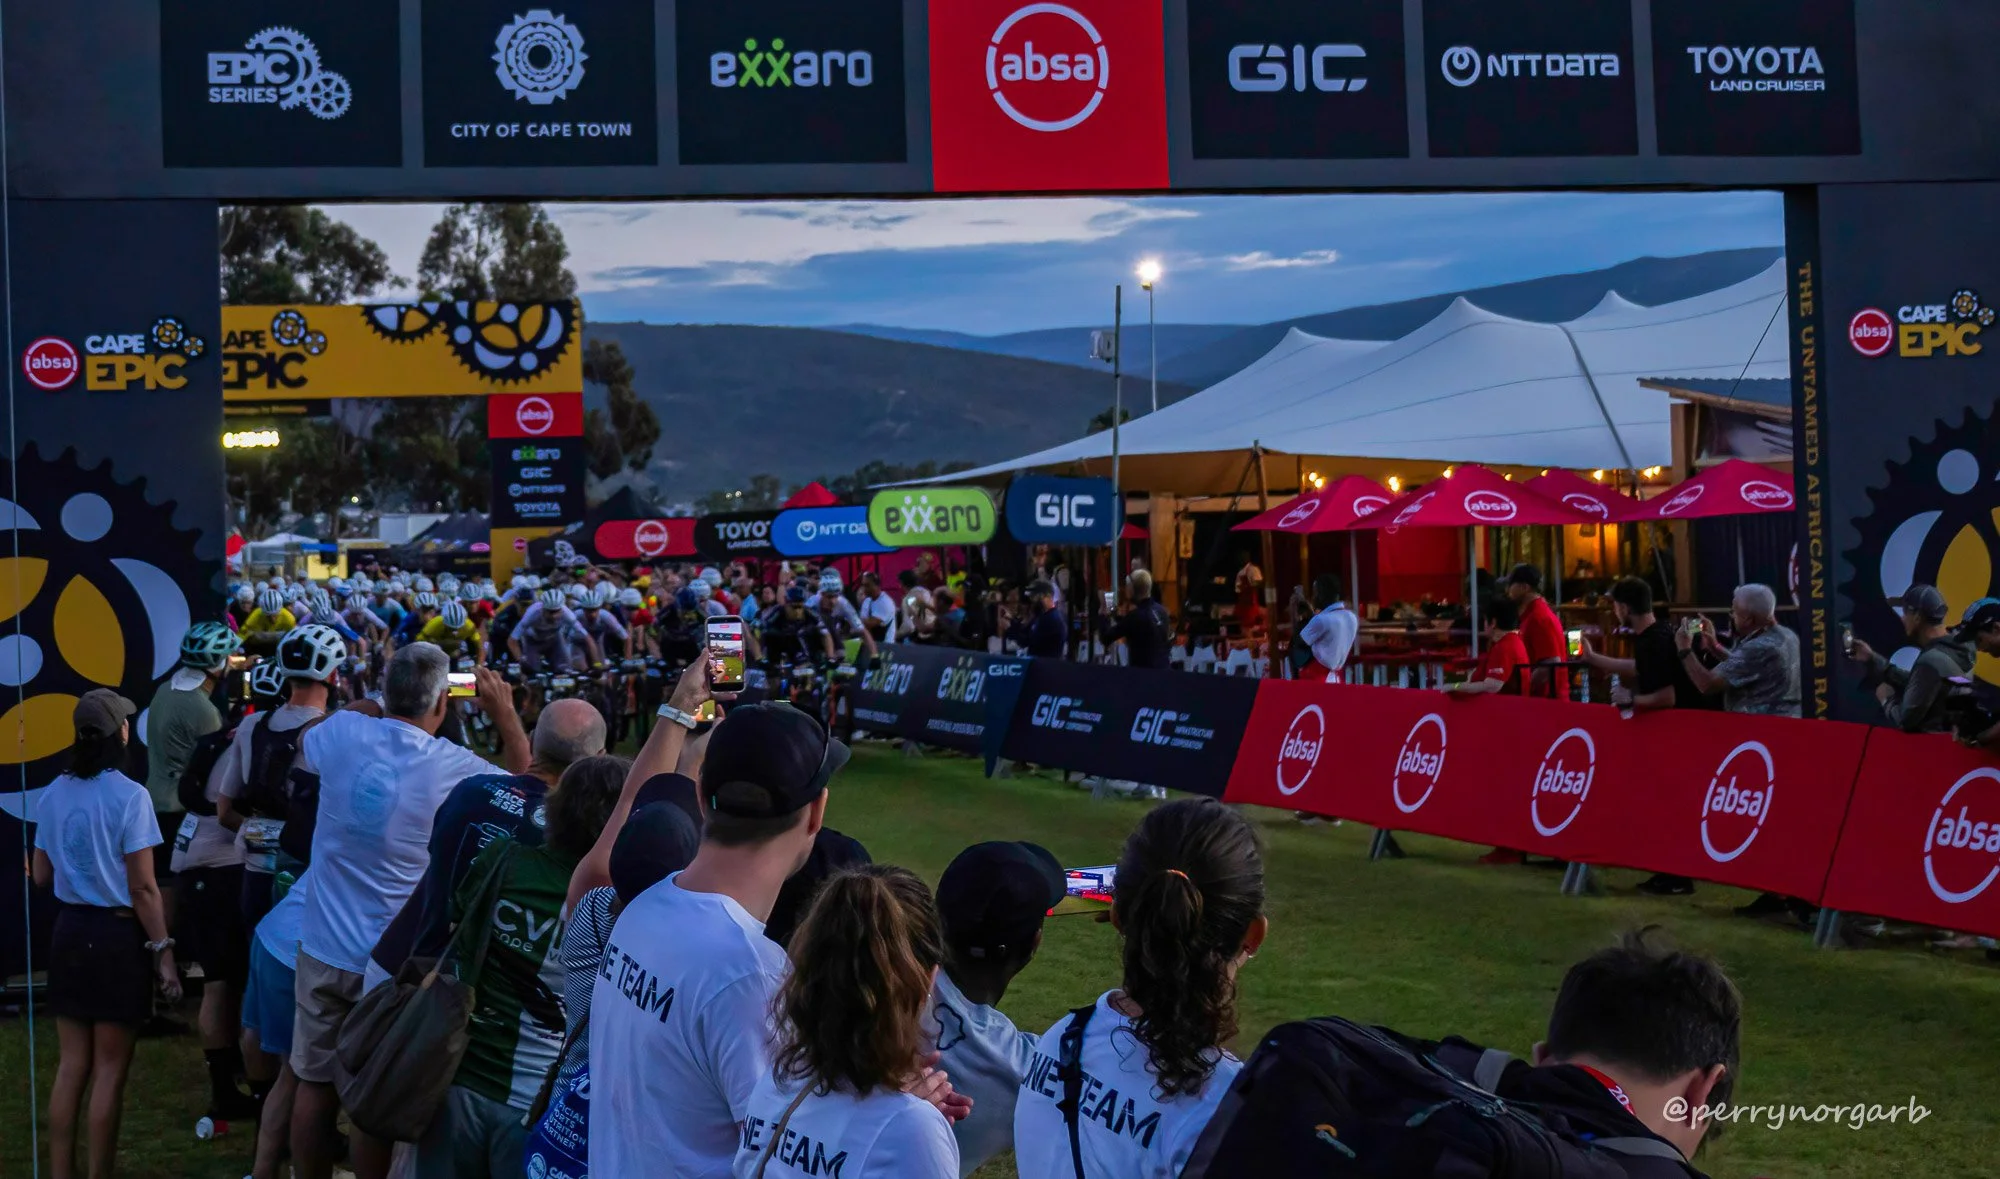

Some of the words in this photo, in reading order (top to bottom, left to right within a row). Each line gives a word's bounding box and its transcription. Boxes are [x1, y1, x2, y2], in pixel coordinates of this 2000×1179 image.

[207, 52, 292, 85] EPIC
[710, 38, 873, 89] exxaro
[1000, 40, 1095, 83] absa
[1227, 44, 1368, 93] GIC
[1486, 53, 1544, 78] NTT
[1687, 45, 1824, 75] TOYOTA
[208, 87, 279, 104] SERIES
[1709, 79, 1752, 92] LAND
[1754, 79, 1826, 92] CRUISER
[450, 122, 492, 138] CITY
[495, 122, 520, 138] OF
[525, 122, 572, 138] CAPE
[576, 121, 632, 138] TOWN
[1798, 262, 1814, 316] THE
[1898, 303, 1947, 324] CAPE
[85, 333, 145, 354] CAPE
[223, 330, 267, 349] APE
[1854, 324, 1890, 339] absa
[1898, 321, 1984, 358] EPIC
[31, 352, 72, 370] absa
[85, 354, 188, 391] EPIC
[1800, 325, 1820, 465] UNTAMED
[520, 408, 549, 421] absa
[513, 502, 562, 513] TOYOTA
[884, 495, 982, 534] exxaro
[1034, 493, 1096, 528] GIC
[1471, 500, 1511, 511] absa
[714, 521, 772, 540] TOYO
[819, 523, 846, 536] NTT
[1805, 473, 1826, 600] AFRICAN
[1812, 609, 1827, 669] MTB
[988, 664, 1022, 677] GIC
[1031, 694, 1073, 729] GIC
[1814, 677, 1829, 720] RA
[1130, 706, 1178, 746] GIC
[1284, 730, 1318, 763] absa
[1400, 741, 1440, 778] absa
[1539, 759, 1587, 796] absa
[494, 788, 527, 807] RACE
[500, 800, 524, 818] SEA
[1710, 776, 1765, 817] absa
[1936, 805, 2000, 853] absa
[617, 953, 675, 1024] TEAM
[1078, 1071, 1162, 1150] TEAM
[1607, 1085, 1630, 1106] 20
[554, 1109, 576, 1129] ORTS
